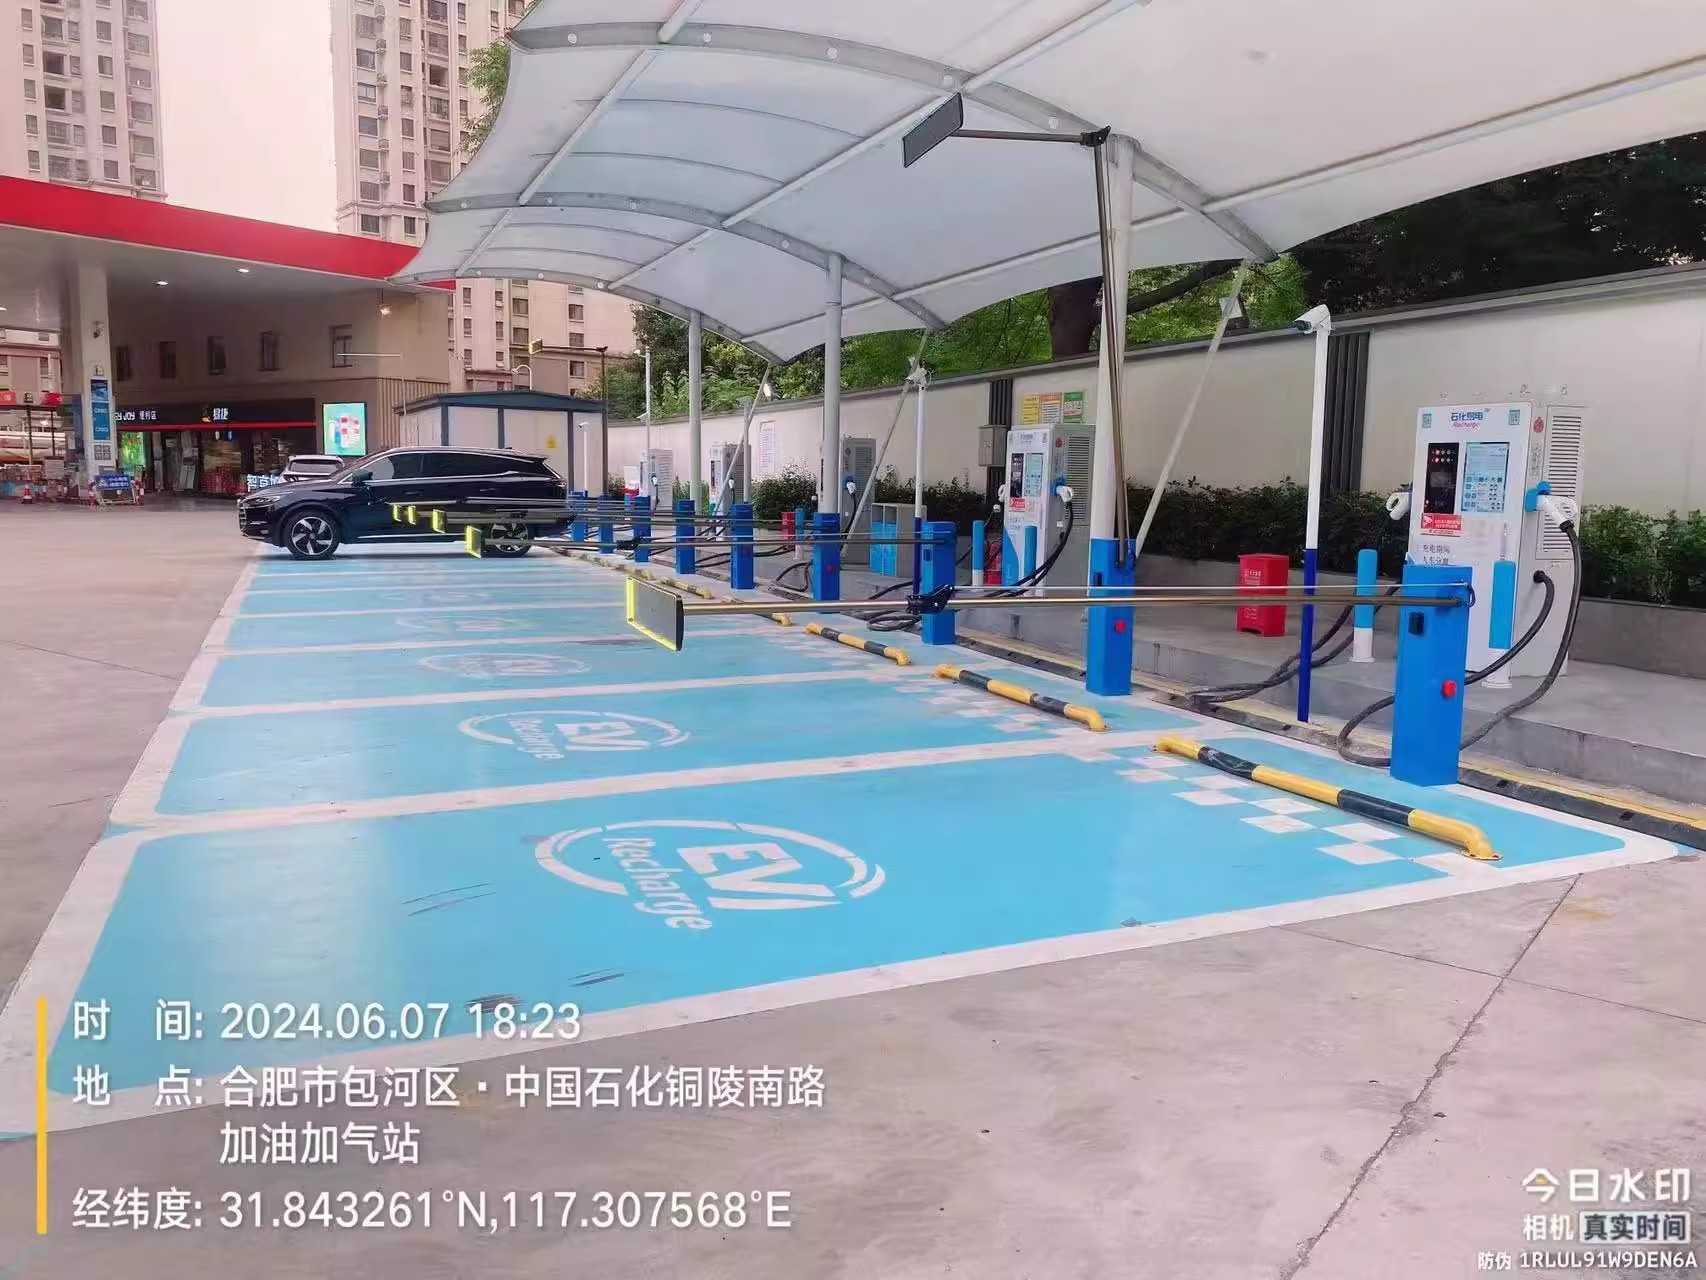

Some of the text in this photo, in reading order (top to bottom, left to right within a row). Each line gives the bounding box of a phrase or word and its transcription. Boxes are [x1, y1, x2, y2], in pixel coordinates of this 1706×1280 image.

[212, 408, 229, 420] 易捷
[601, 837, 713, 930] Recharge
[676, 842, 842, 910] EV
